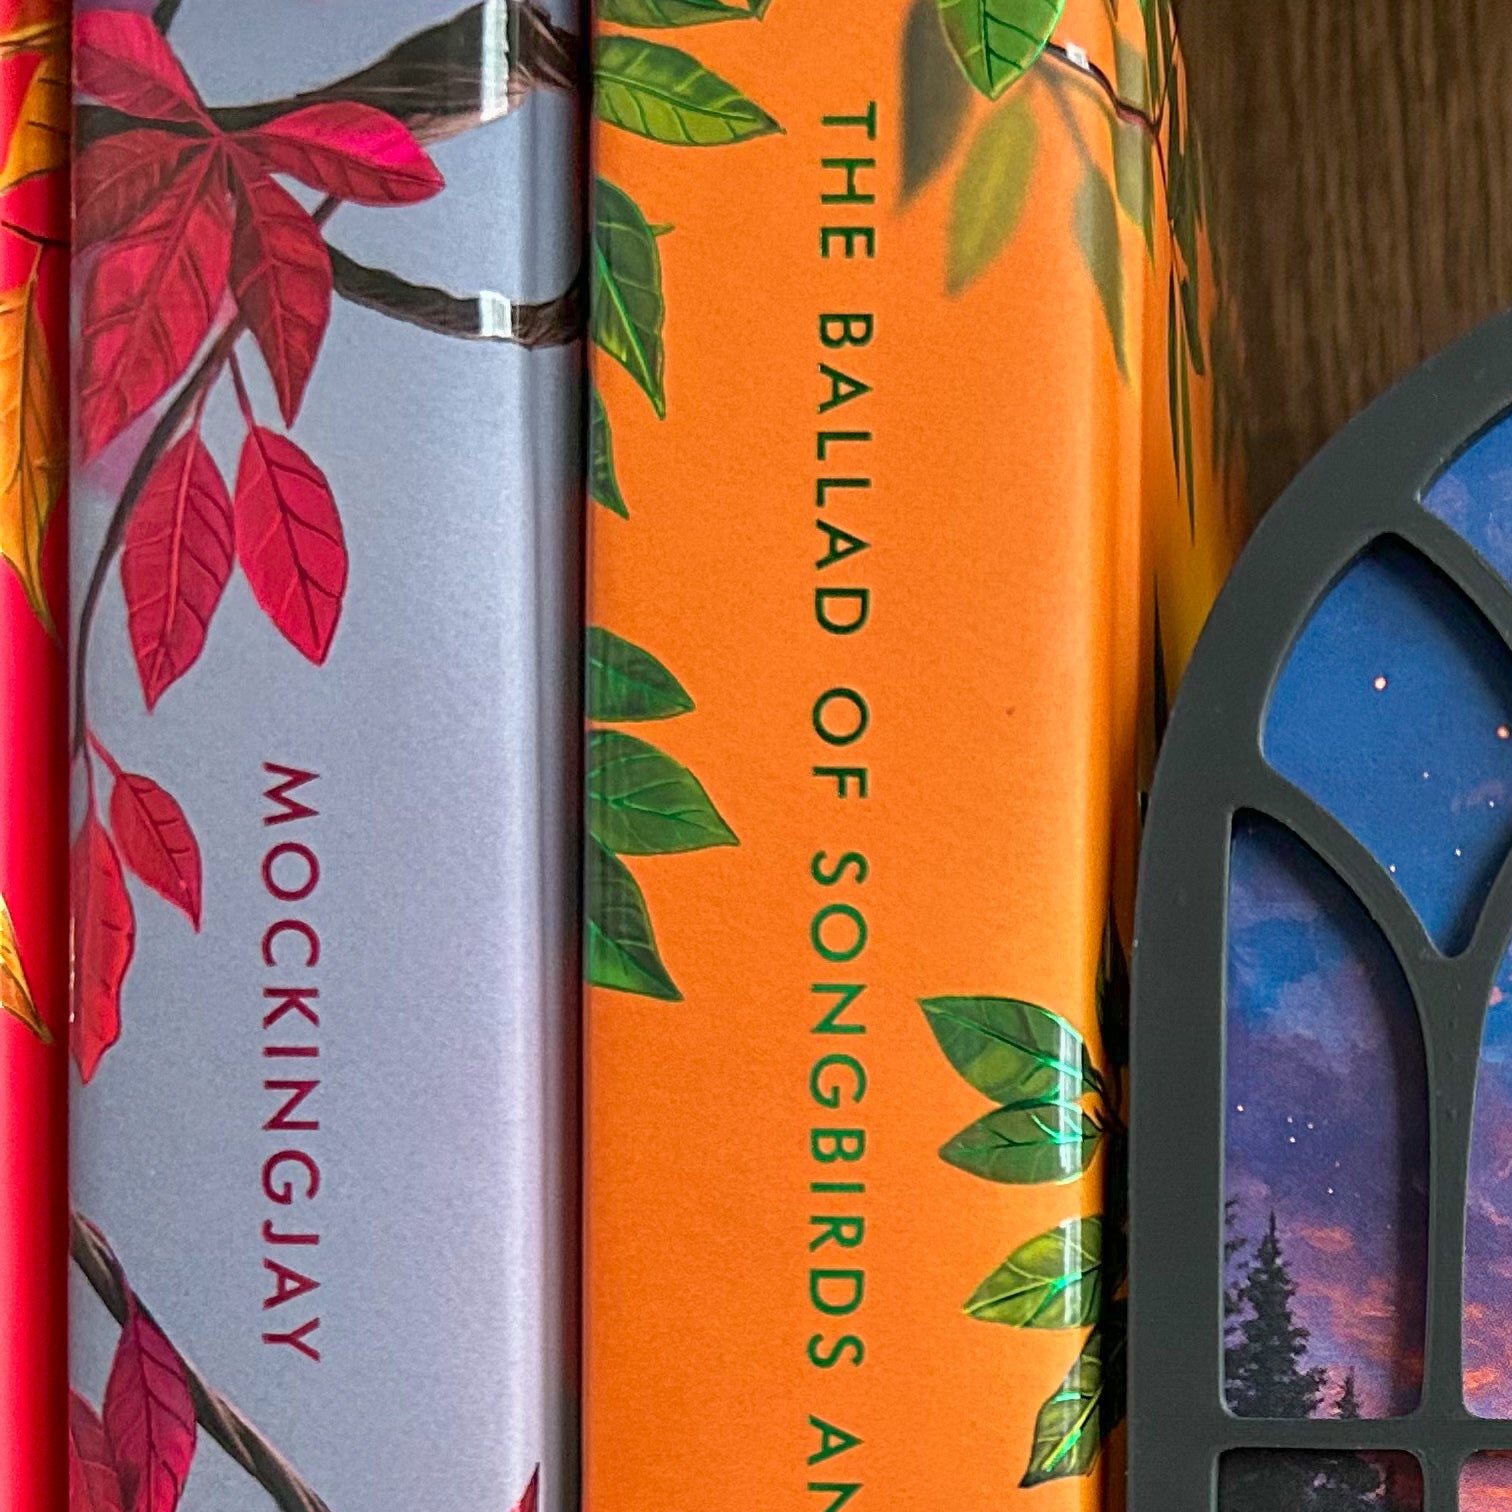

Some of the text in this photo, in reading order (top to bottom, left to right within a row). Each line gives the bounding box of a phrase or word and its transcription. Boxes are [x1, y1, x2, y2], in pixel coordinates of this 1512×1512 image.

[818, 100, 877, 260] THE
[814, 312, 874, 636] BALLAD
[811, 686, 870, 800] OF
[261, 761, 320, 1361] MOCKINGJAY
[807, 850, 869, 1370] SONGBIRDS
